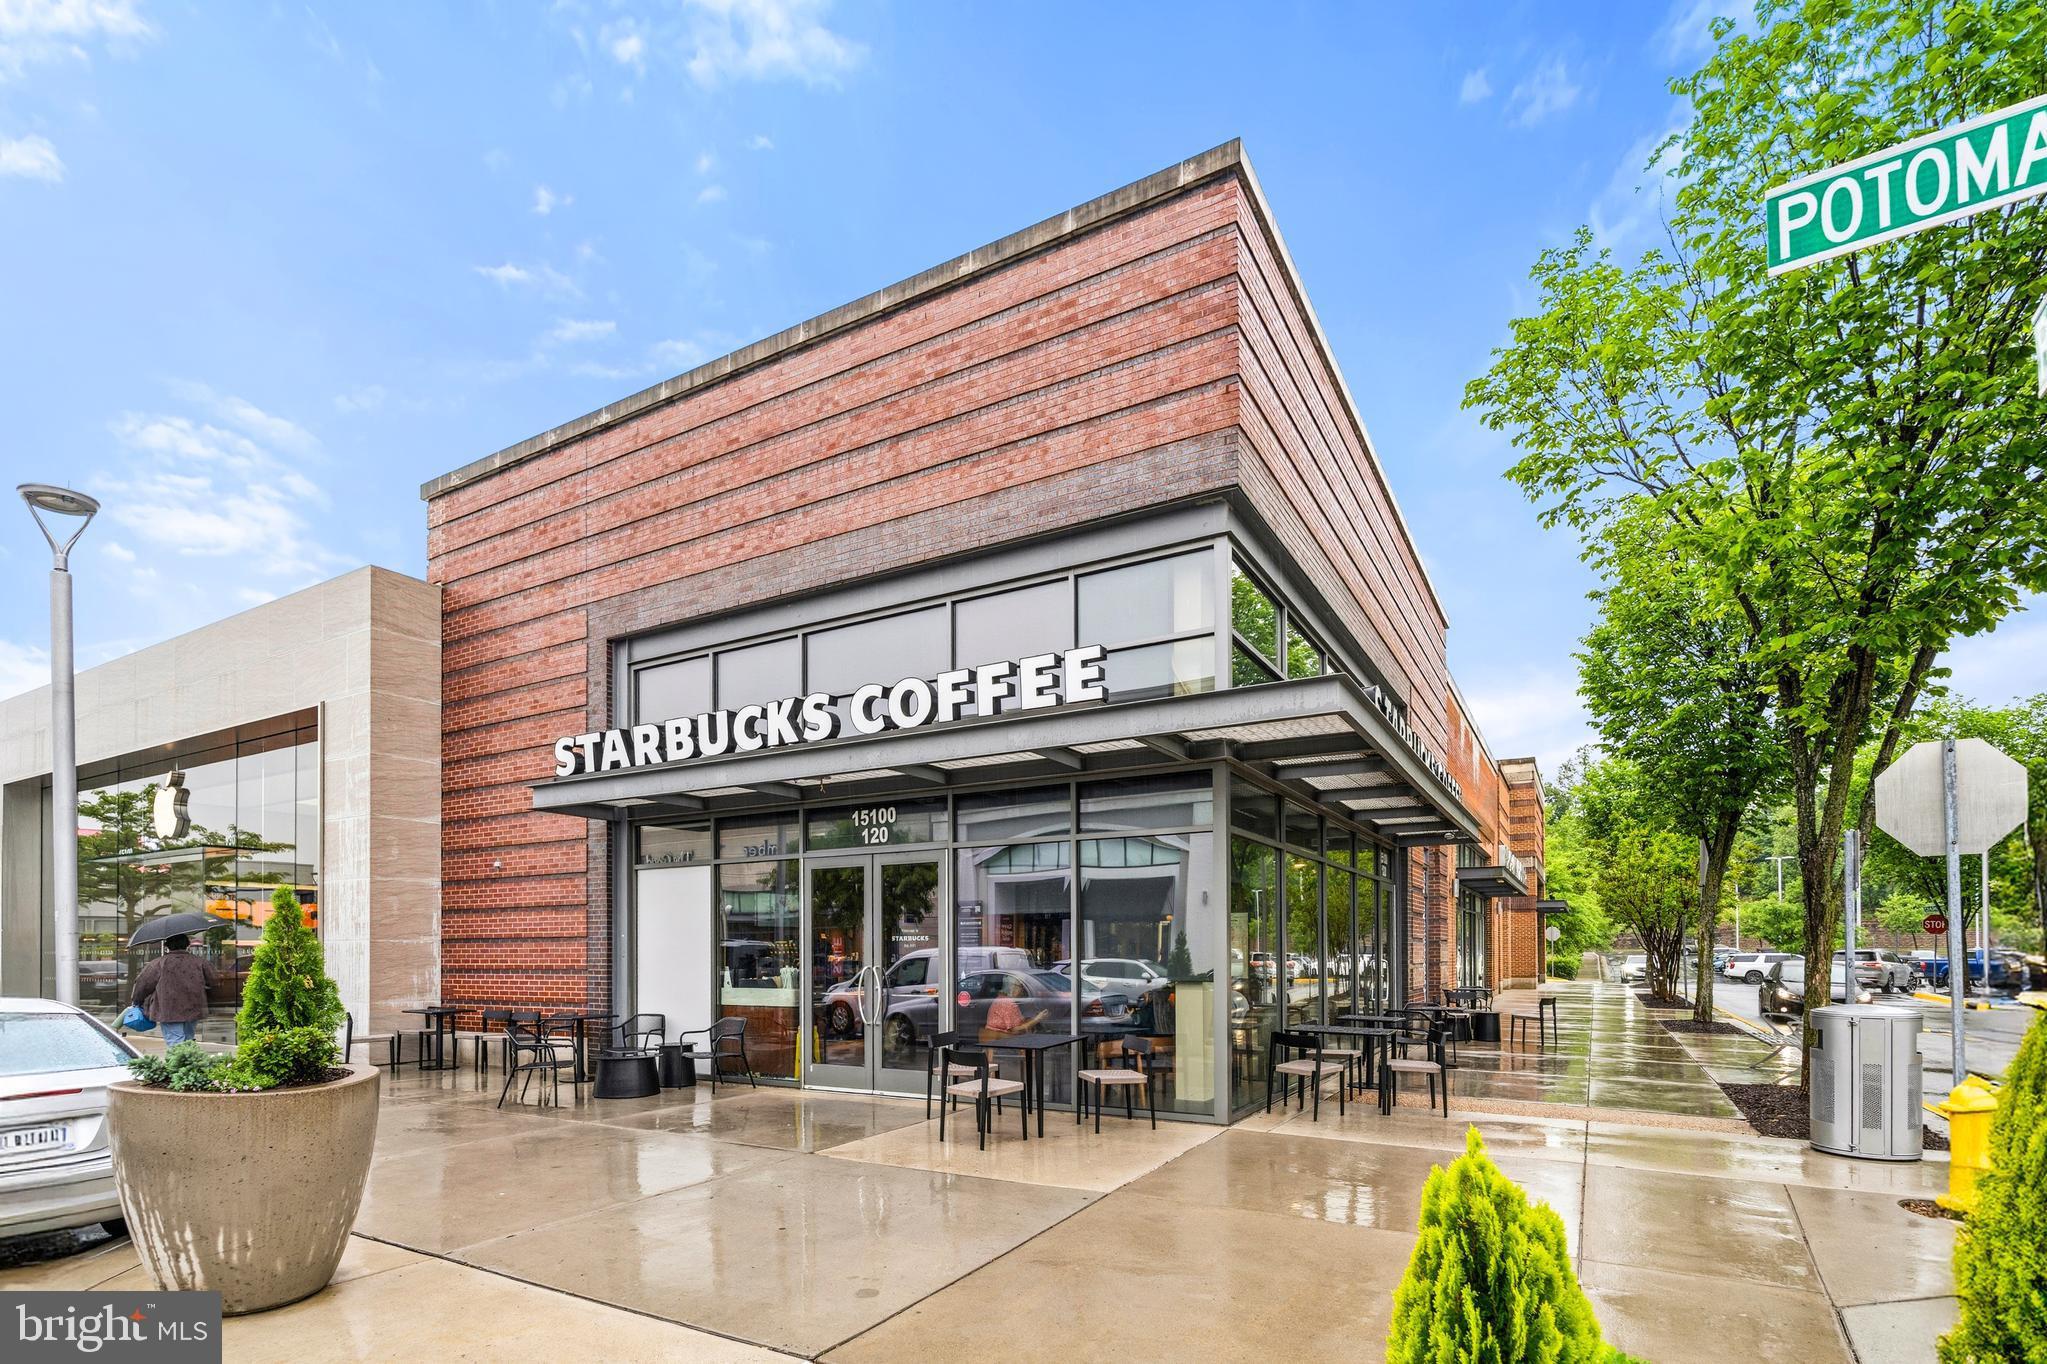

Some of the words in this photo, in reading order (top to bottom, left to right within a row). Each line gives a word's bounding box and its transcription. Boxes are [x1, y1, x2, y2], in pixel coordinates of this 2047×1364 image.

[554, 692, 836, 777] STARBUCKS
[850, 645, 1107, 734] COFFEE
[852, 807, 896, 826] 15100
[862, 826, 888, 844] 120
